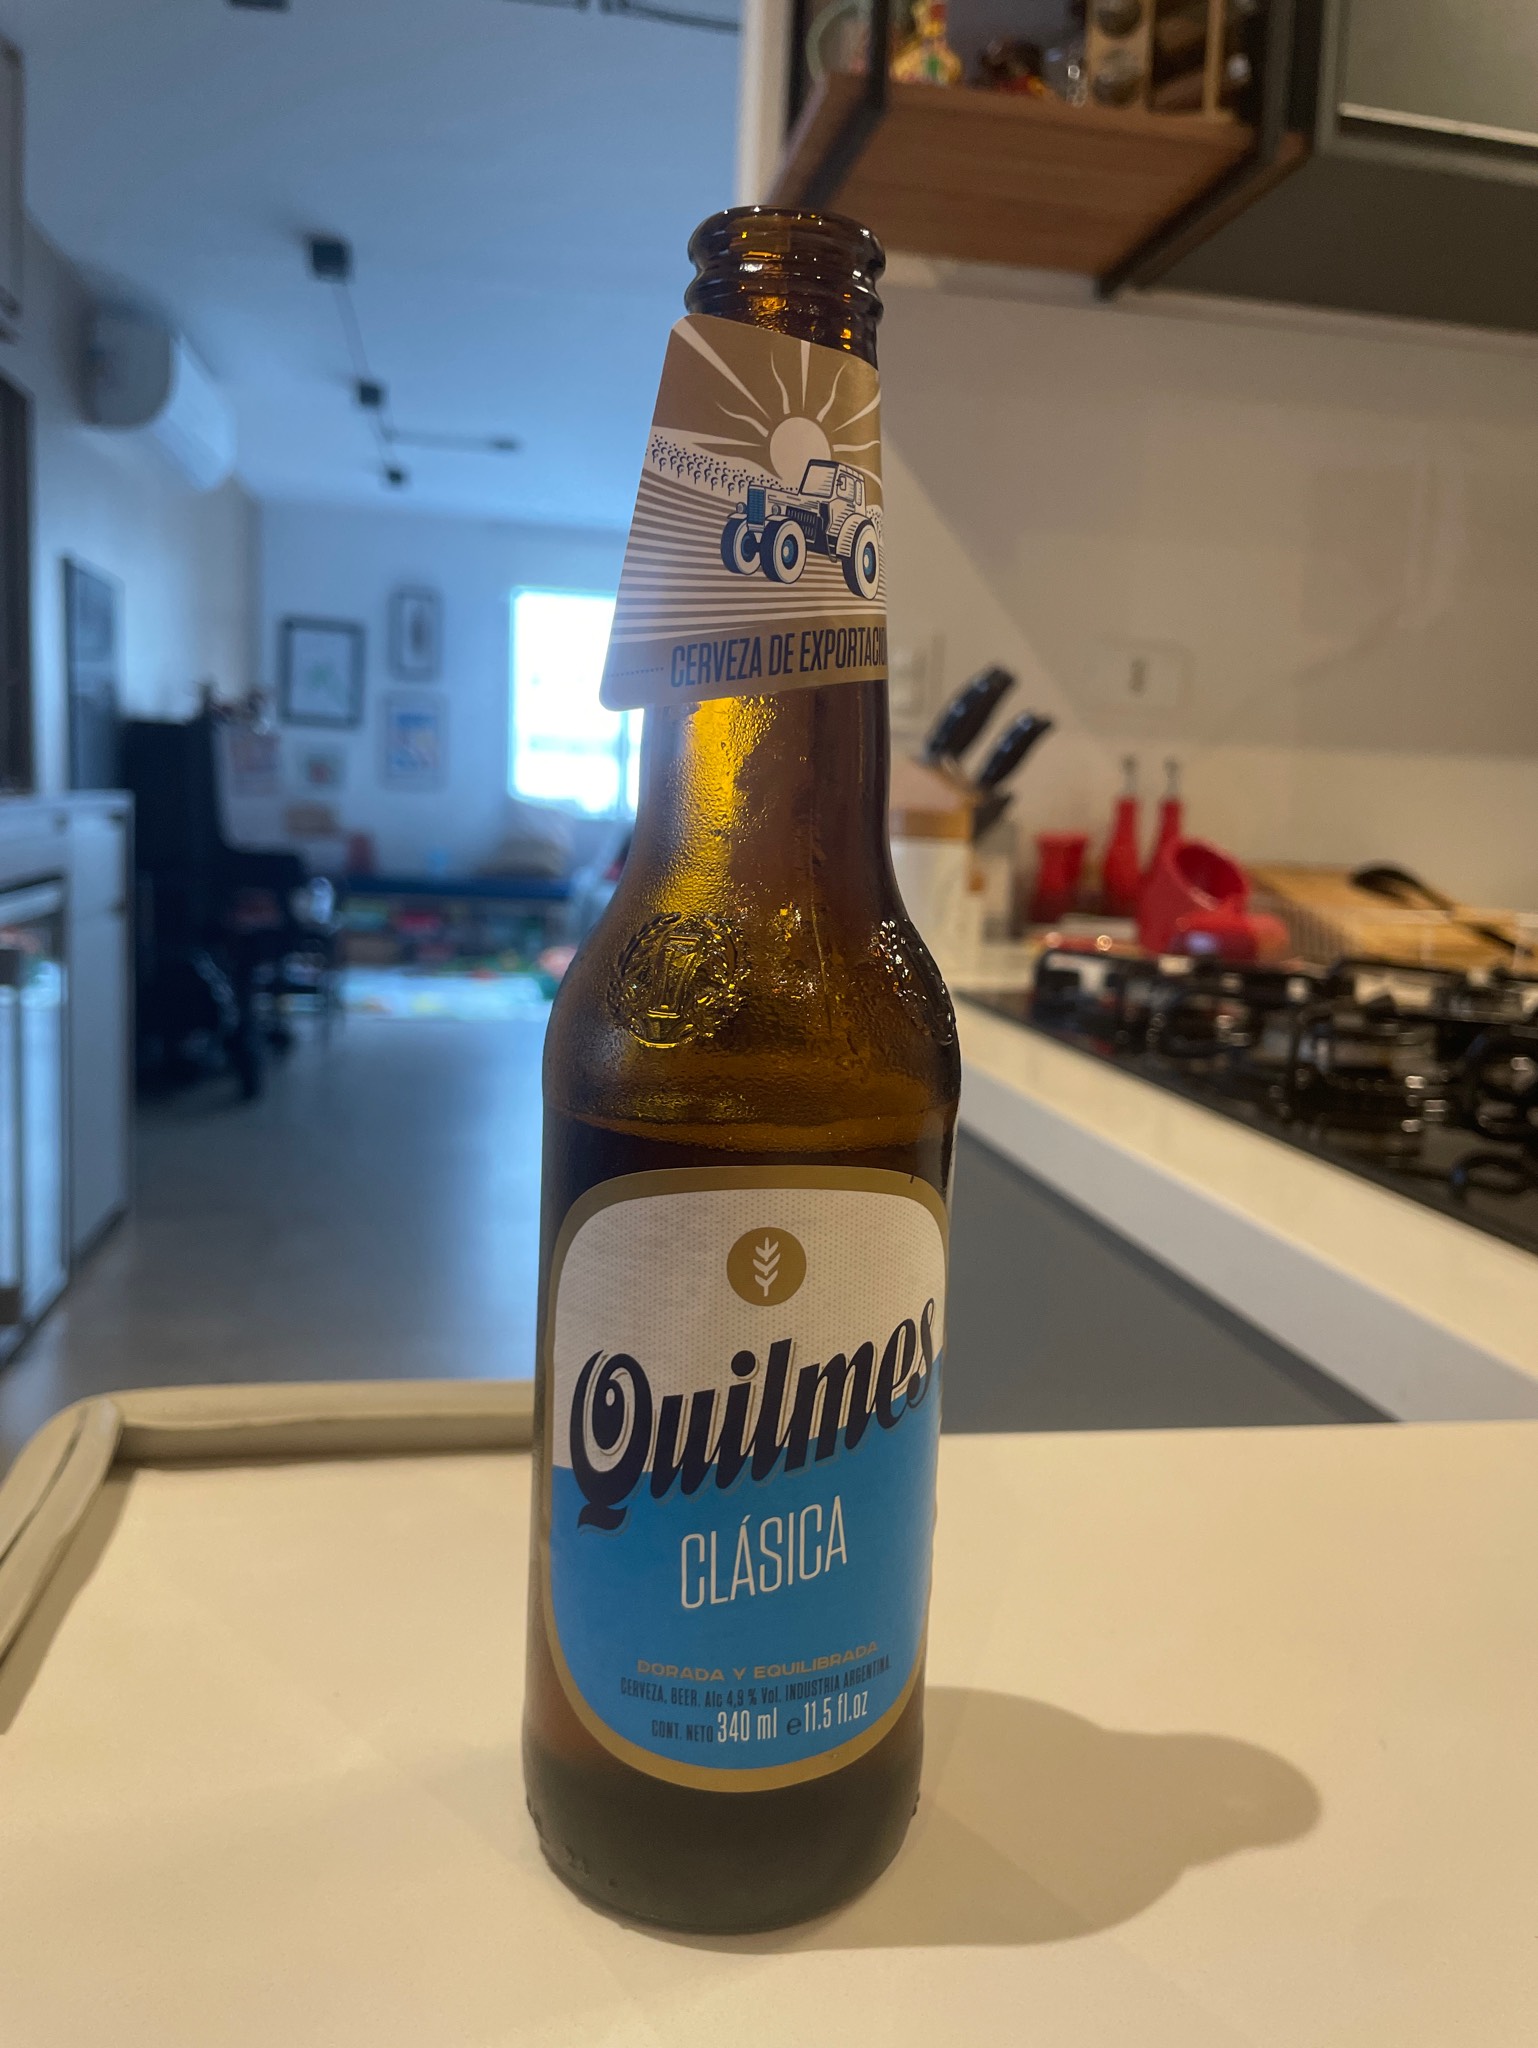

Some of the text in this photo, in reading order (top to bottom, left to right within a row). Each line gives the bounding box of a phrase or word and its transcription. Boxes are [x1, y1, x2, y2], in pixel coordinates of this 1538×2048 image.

[671, 636, 762, 688] CERVEZA
[768, 632, 795, 676] DE
[569, 1297, 935, 1532] Quilmes
[680, 1495, 848, 1609] CLÁSICA
[637, 1641, 878, 1681] DORADA Y EQUILIBRADA
[705, 1691, 723, 1707] Alc
[748, 1687, 757, 1705] %
[761, 1686, 782, 1704] Vol.
[785, 1674, 840, 1701] INDUSTRIA
[686, 1724, 714, 1743] NETO
[717, 1709, 750, 1743] 340
[757, 1706, 777, 1740] ml
[804, 1696, 832, 1733] 11.5
